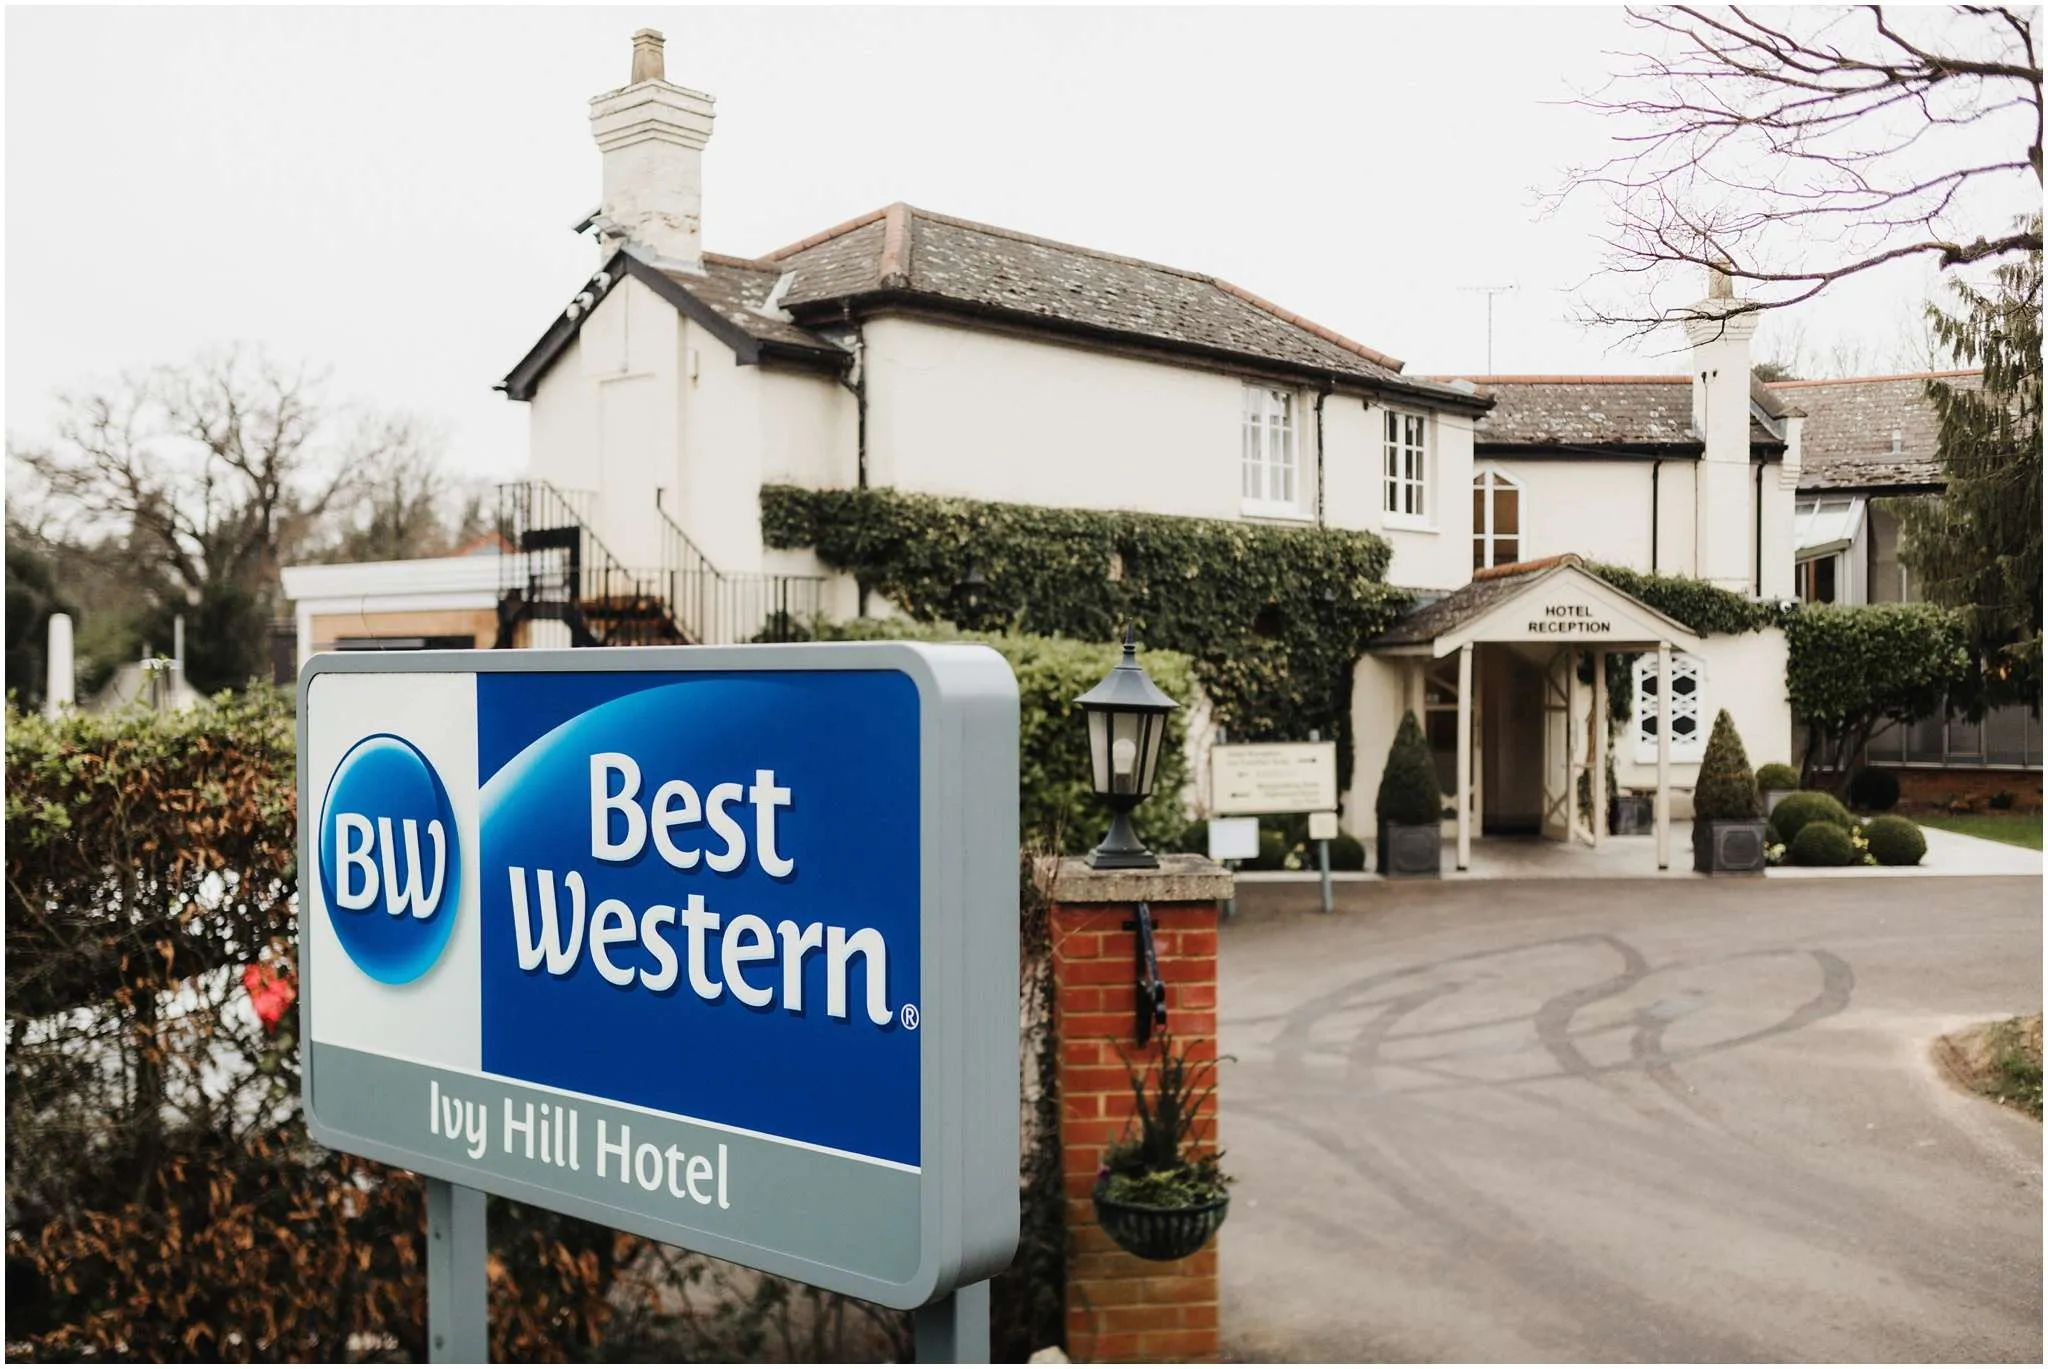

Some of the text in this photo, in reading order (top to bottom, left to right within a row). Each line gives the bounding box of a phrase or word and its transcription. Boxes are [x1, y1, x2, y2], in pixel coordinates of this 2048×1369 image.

[1528, 621, 1611, 633] RECEPTION
[1545, 605, 1593, 617] HOTEL
[335, 813, 447, 919] BW
[590, 752, 794, 878] Best
[509, 866, 894, 1026] Western
[430, 1080, 731, 1209] Ivy Hill Hotel
